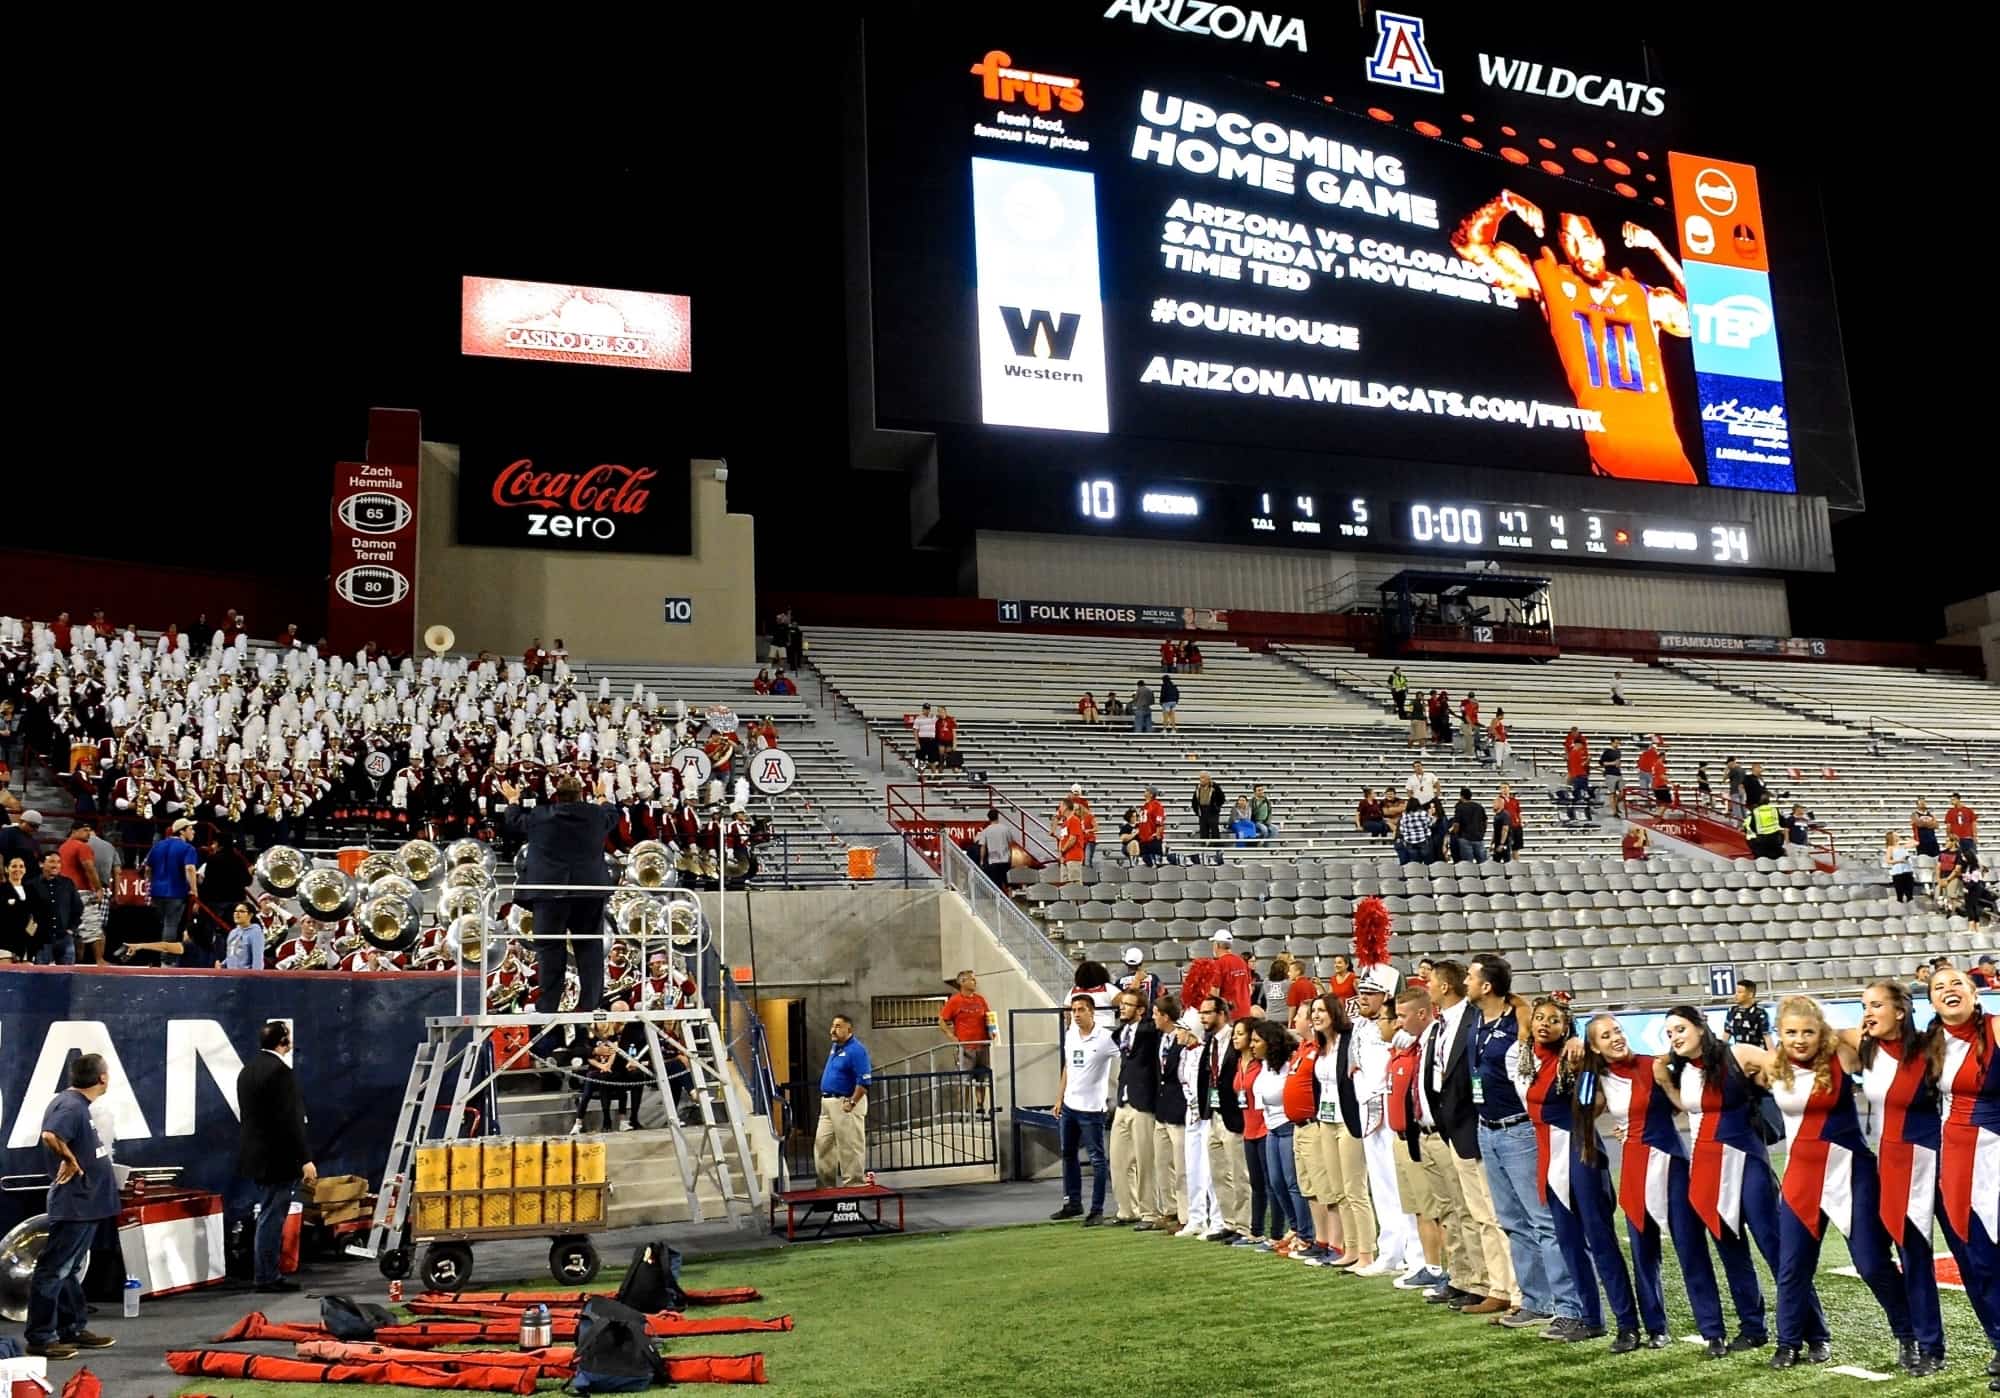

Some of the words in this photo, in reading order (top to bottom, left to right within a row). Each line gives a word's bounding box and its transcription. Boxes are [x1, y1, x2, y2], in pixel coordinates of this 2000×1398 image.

[1104, 0, 1307, 53] ARIZONA
[970, 50, 1084, 112] fry's
[1479, 53, 1666, 117] WILDCATS
[1033, 116, 1064, 134] food,
[1025, 131, 1049, 145] low
[1141, 90, 1405, 186] UPCOMING
[1132, 126, 1295, 195] HOME
[1306, 171, 1440, 230] GAME
[1165, 198, 1312, 246] ARIZONA
[1316, 228, 1354, 255] VS
[1358, 238, 1500, 283] COLORADO
[1160, 244, 1241, 280] TIME
[1248, 260, 1311, 291] TBD
[1163, 221, 1345, 279] SATURDAY,
[1349, 257, 1492, 304] NOVEMBER
[1492, 287, 1519, 309] 12
[1151, 298, 1360, 351] #OURHOUSE
[1572, 311, 1645, 393] 10
[1004, 364, 1084, 393] Western
[1140, 356, 1606, 433] ARIZONAWILDCATS.COM/FBTIX
[349, 476, 403, 489] Hemmila
[361, 465, 393, 477] Zach
[1080, 480, 1116, 520] 10
[1262, 493, 1270, 514] 1
[1297, 496, 1313, 517] 4
[1352, 499, 1368, 522] 5
[366, 508, 384, 519] 65
[1411, 504, 1483, 544] 0:00
[1499, 511, 1528, 533] 47
[1550, 515, 1565, 535] 4
[528, 514, 616, 539] zero
[1339, 524, 1353, 536] TO
[1354, 525, 1369, 537] GO
[1587, 516, 1602, 539] 3
[351, 537, 397, 550] Damon
[354, 549, 394, 561] Terrell
[1710, 525, 1750, 563] 34
[364, 582, 382, 592] 80
[665, 602, 691, 621] 10
[1001, 603, 1018, 619] 11
[1030, 605, 1070, 620] FOLK
[1074, 607, 1136, 622] HEROES
[1474, 626, 1494, 642] 12
[1811, 642, 1826, 655] 13
[1713, 971, 1733, 995] 11
[0, 1018, 293, 1149] AN
